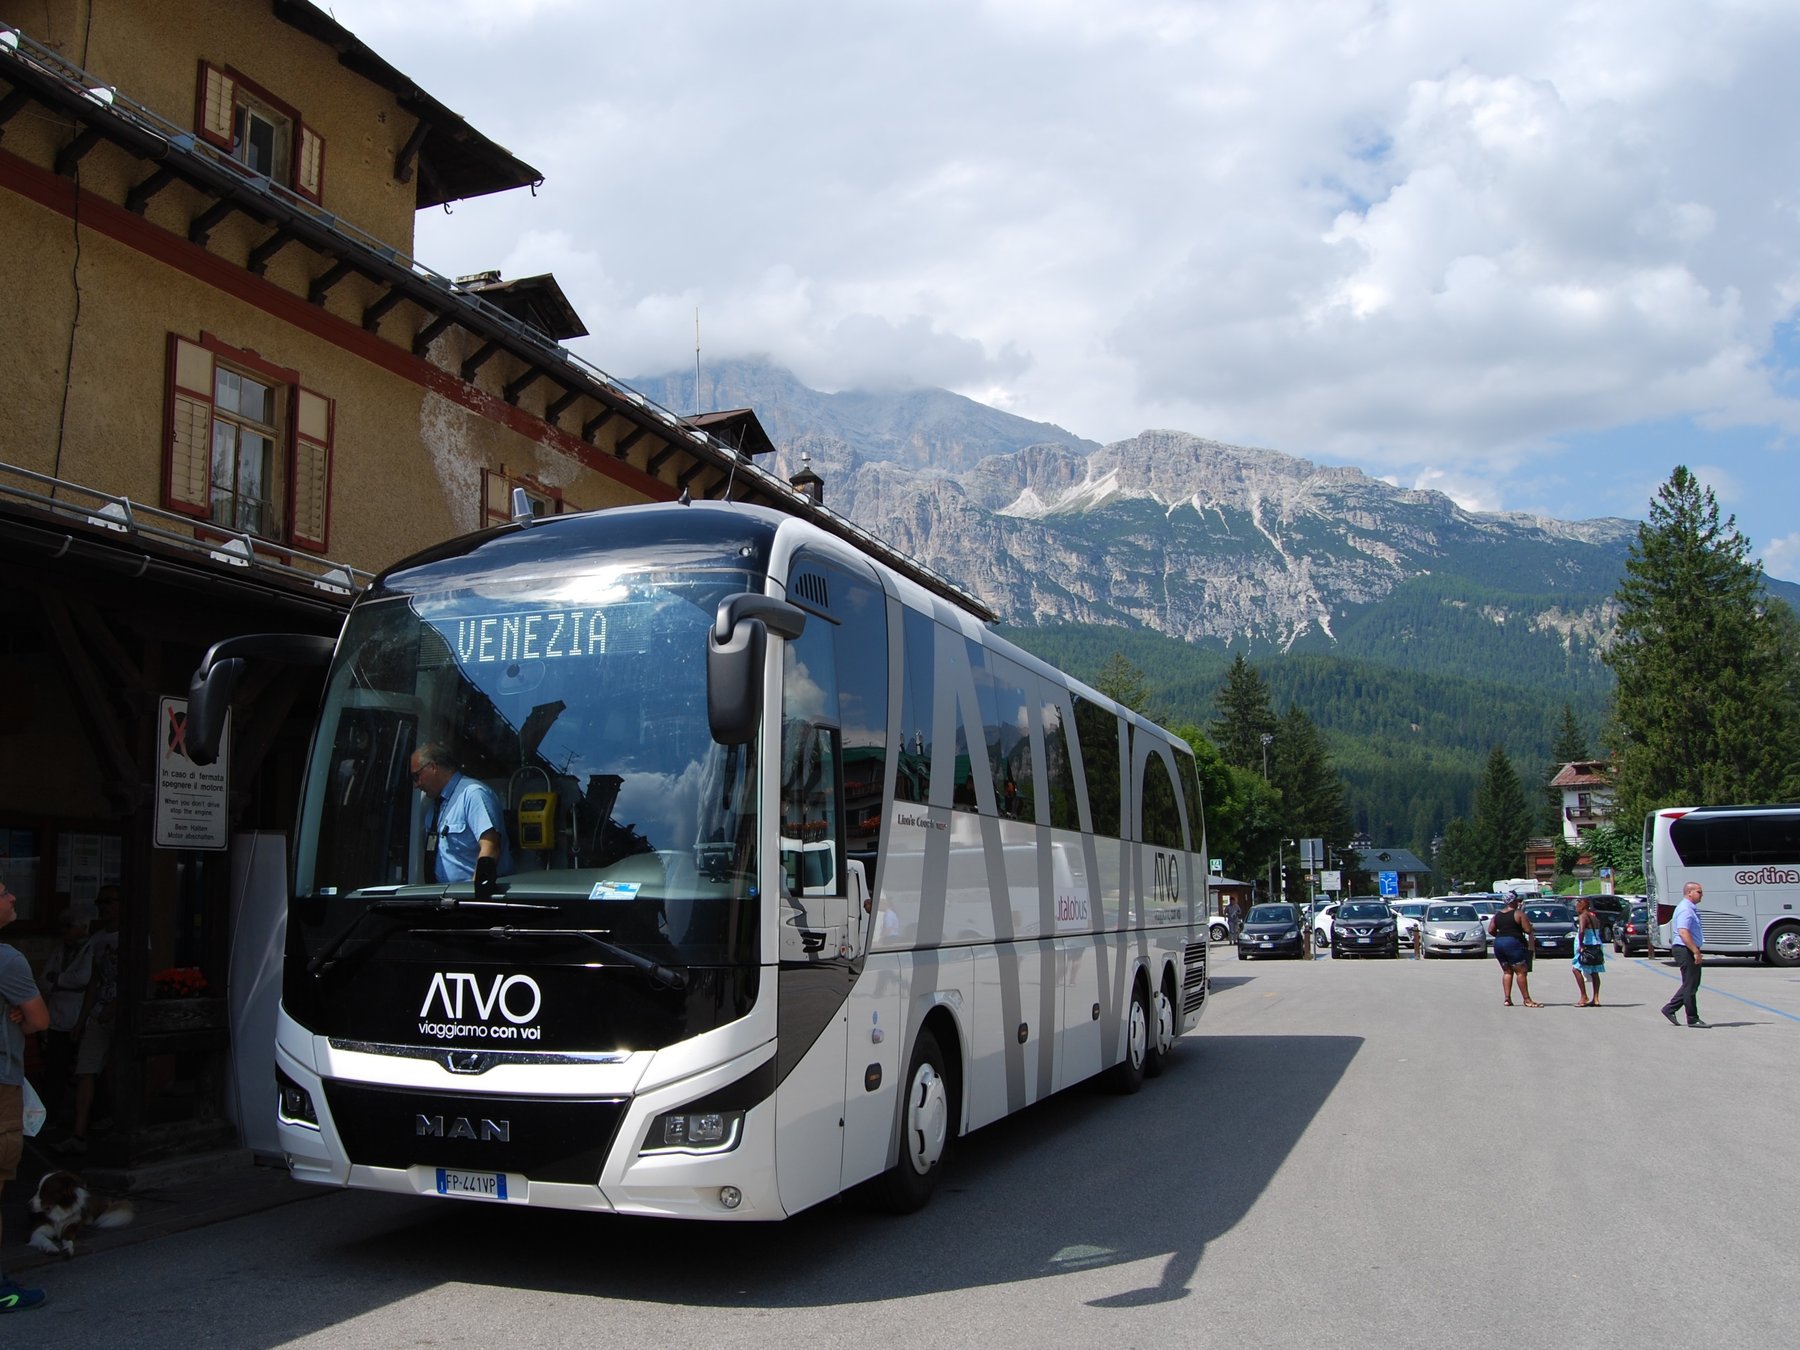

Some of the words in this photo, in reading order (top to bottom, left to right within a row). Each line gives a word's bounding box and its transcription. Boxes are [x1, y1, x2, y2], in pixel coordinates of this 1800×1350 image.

[458, 610, 607, 663] VENEZIA
[162, 769, 169, 777] In
[171, 770, 187, 778] caso
[189, 771, 196, 779] di
[199, 773, 225, 782] fermata
[162, 781, 192, 790] spegnere
[194, 782, 198, 790] il
[1154, 852, 1179, 903] ATVO
[1735, 866, 1800, 885] cortina
[420, 972, 542, 1024] ATVO
[418, 1020, 488, 1039] viaggiamo
[490, 1026, 517, 1039] con
[520, 1025, 541, 1040] voi
[415, 1113, 510, 1142] MAN
